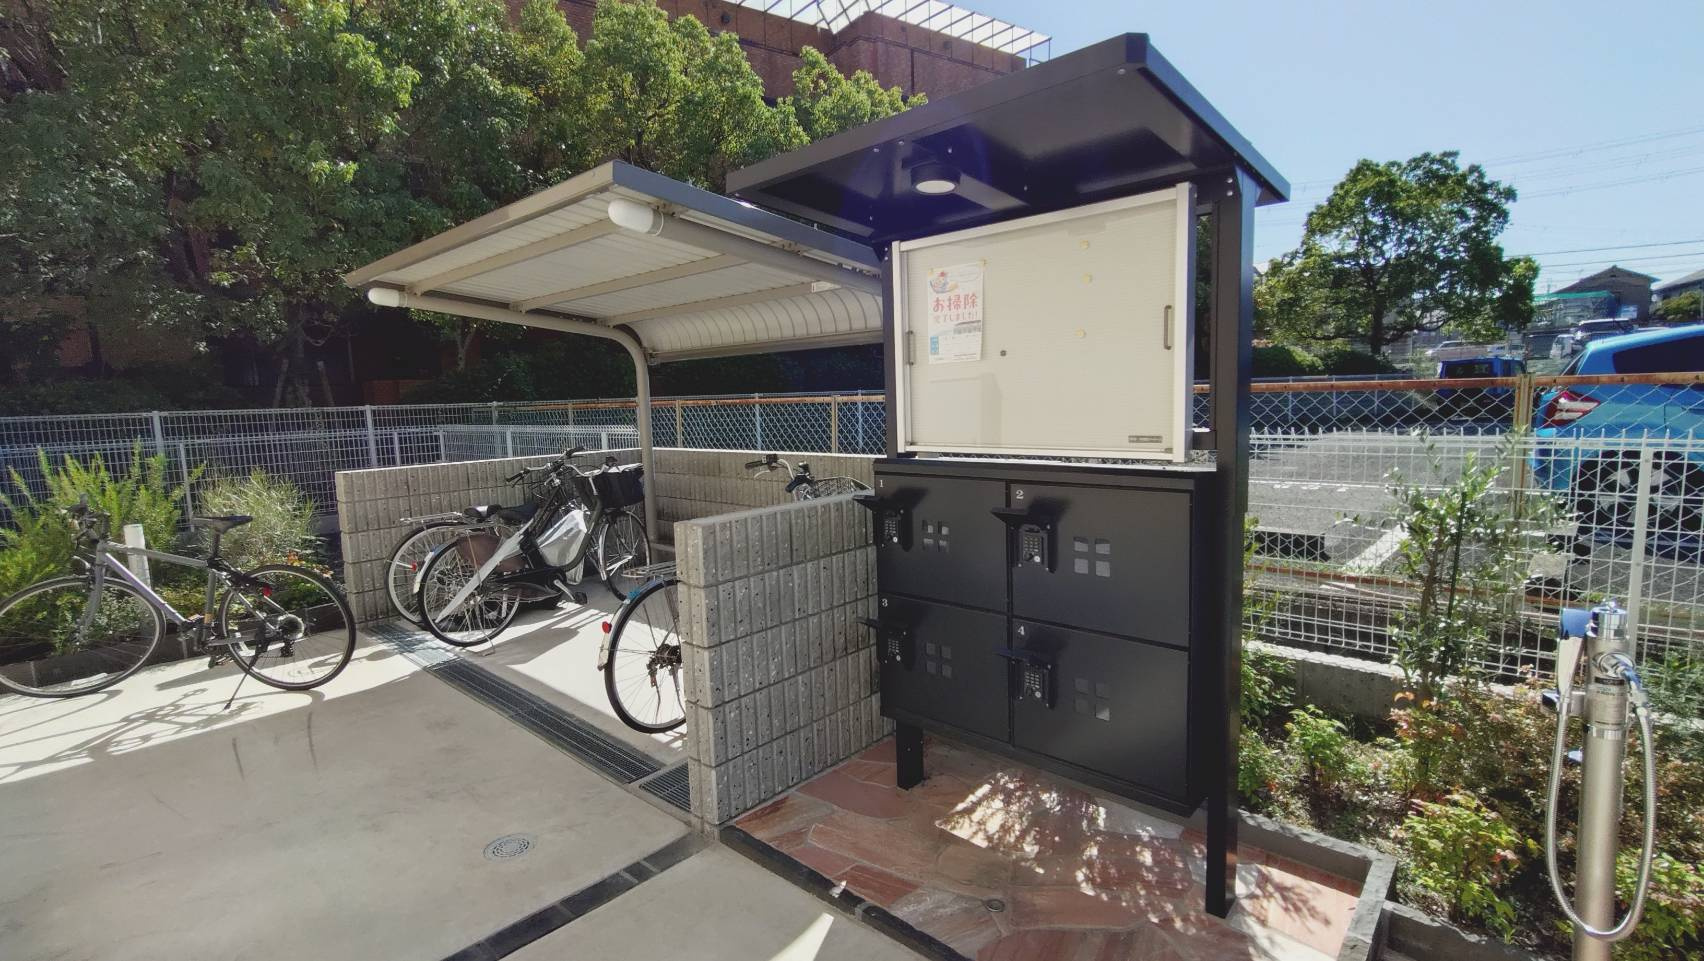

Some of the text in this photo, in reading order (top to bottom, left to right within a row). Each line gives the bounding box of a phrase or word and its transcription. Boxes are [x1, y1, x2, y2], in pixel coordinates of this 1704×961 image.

[933, 294, 978, 312] お掃除
[879, 479, 884, 488] 1
[1015, 490, 1024, 499] 2
[881, 598, 888, 607] 3
[1017, 626, 1025, 635] 4
